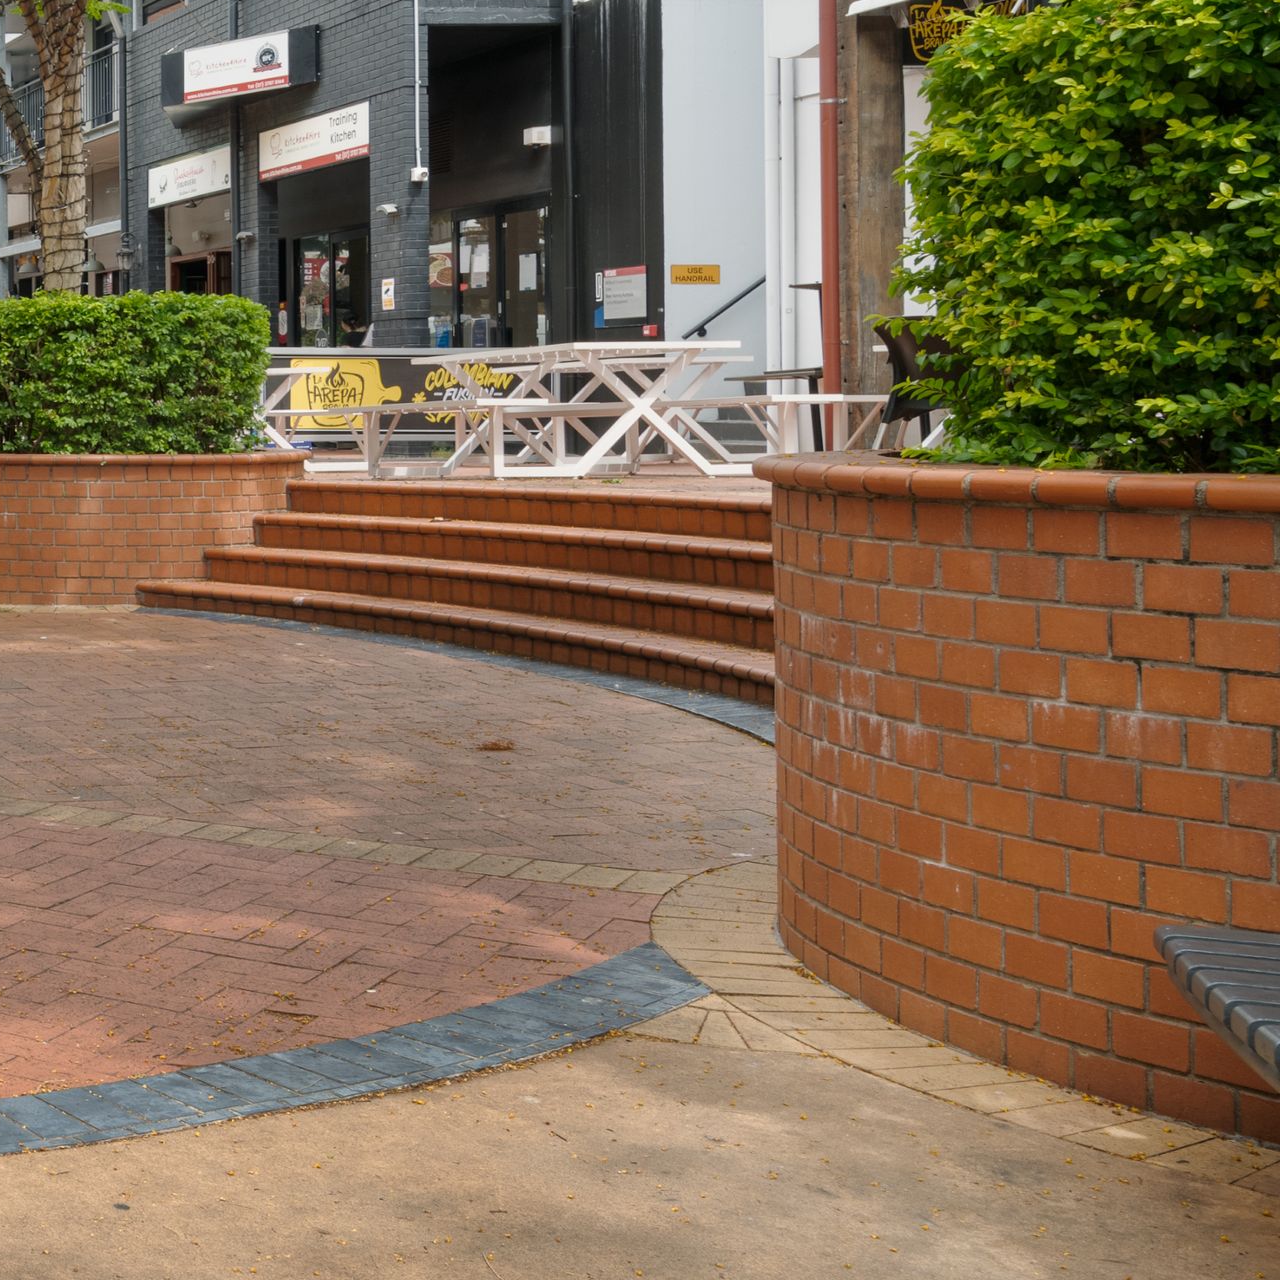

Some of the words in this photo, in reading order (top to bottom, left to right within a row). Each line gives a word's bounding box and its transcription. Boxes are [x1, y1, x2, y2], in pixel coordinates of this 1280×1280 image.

[915, 21, 958, 38] AREPA
[329, 112, 358, 127] Training
[330, 129, 357, 144] Kitchen
[313, 385, 357, 404] AREPA
